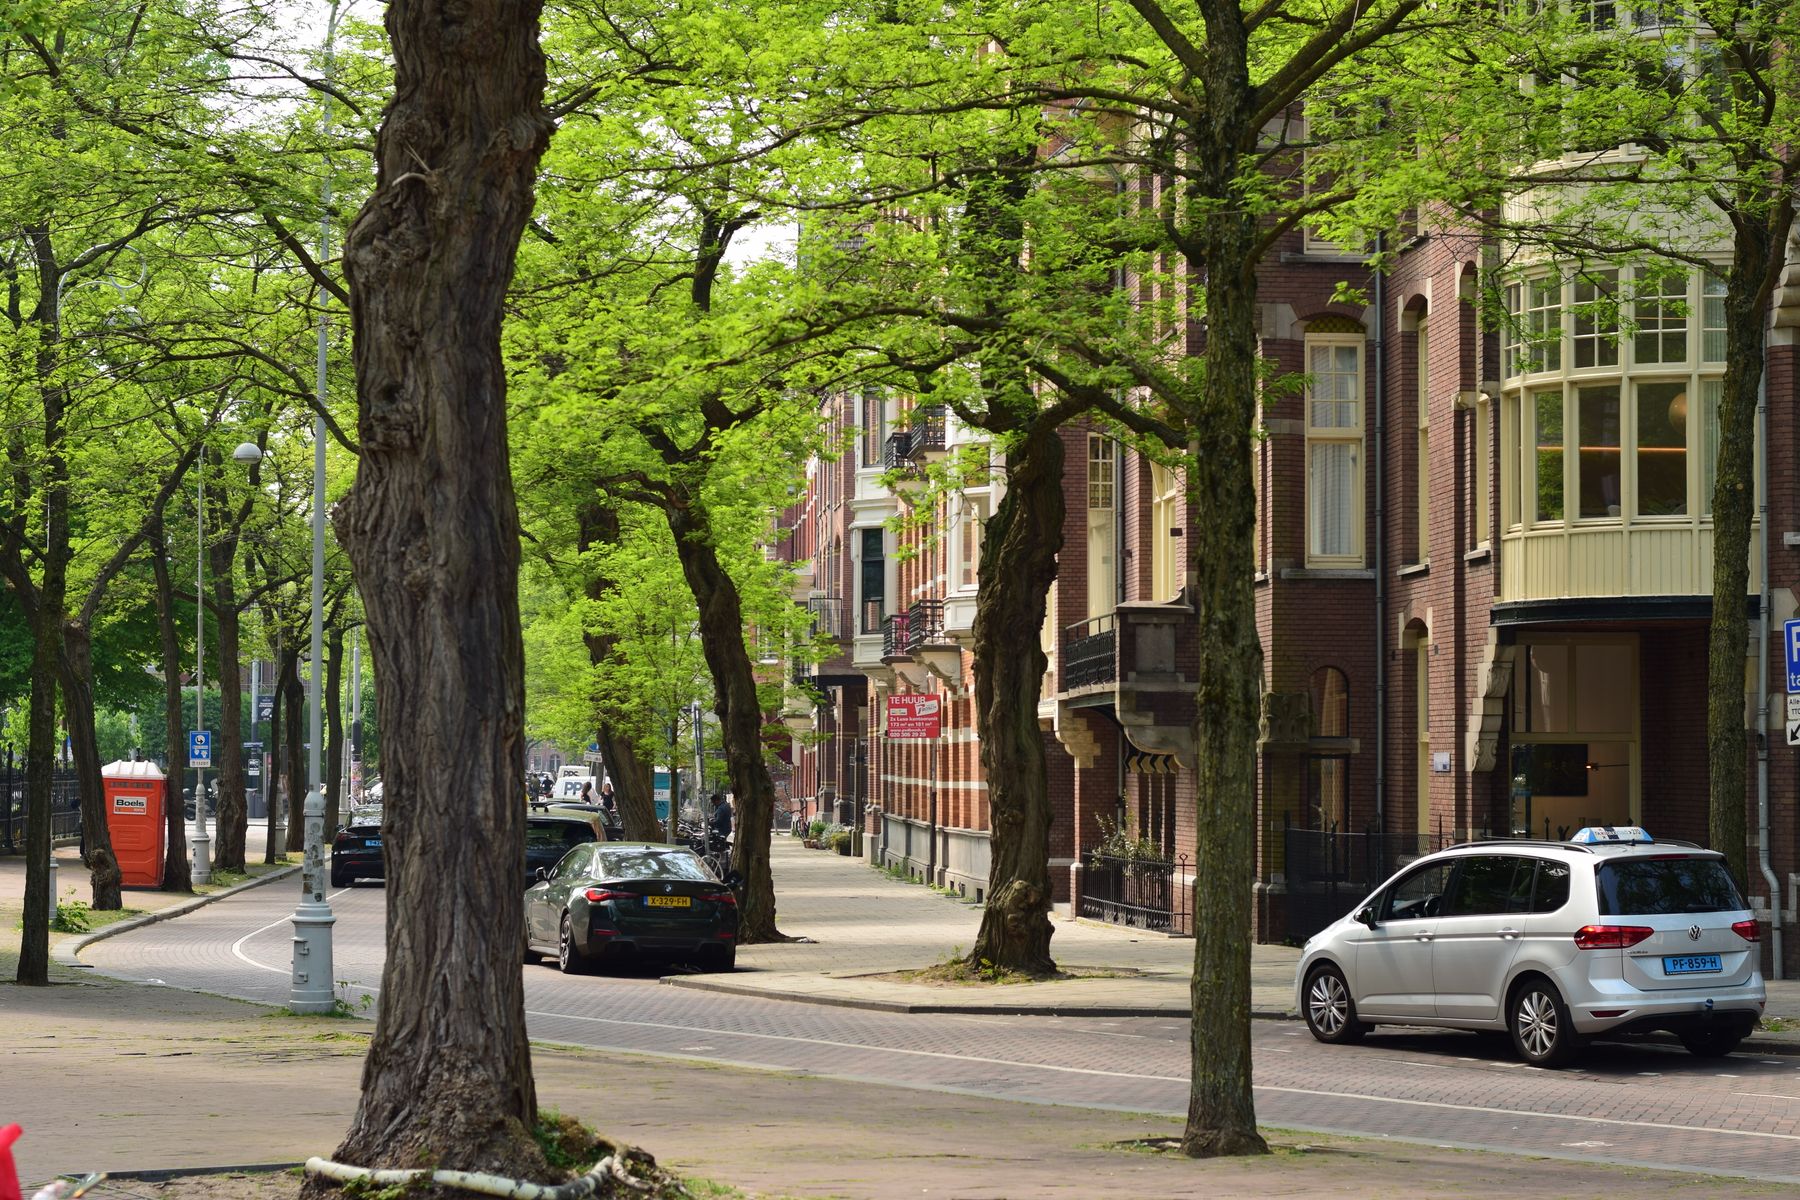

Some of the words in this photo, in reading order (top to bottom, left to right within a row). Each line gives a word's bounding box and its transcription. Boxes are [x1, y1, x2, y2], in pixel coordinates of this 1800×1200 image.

[890, 696, 900, 704] TE
[564, 781, 583, 795] PP
[116, 799, 145, 807] Boels
[1672, 956, 1717, 969] PF-859-H
